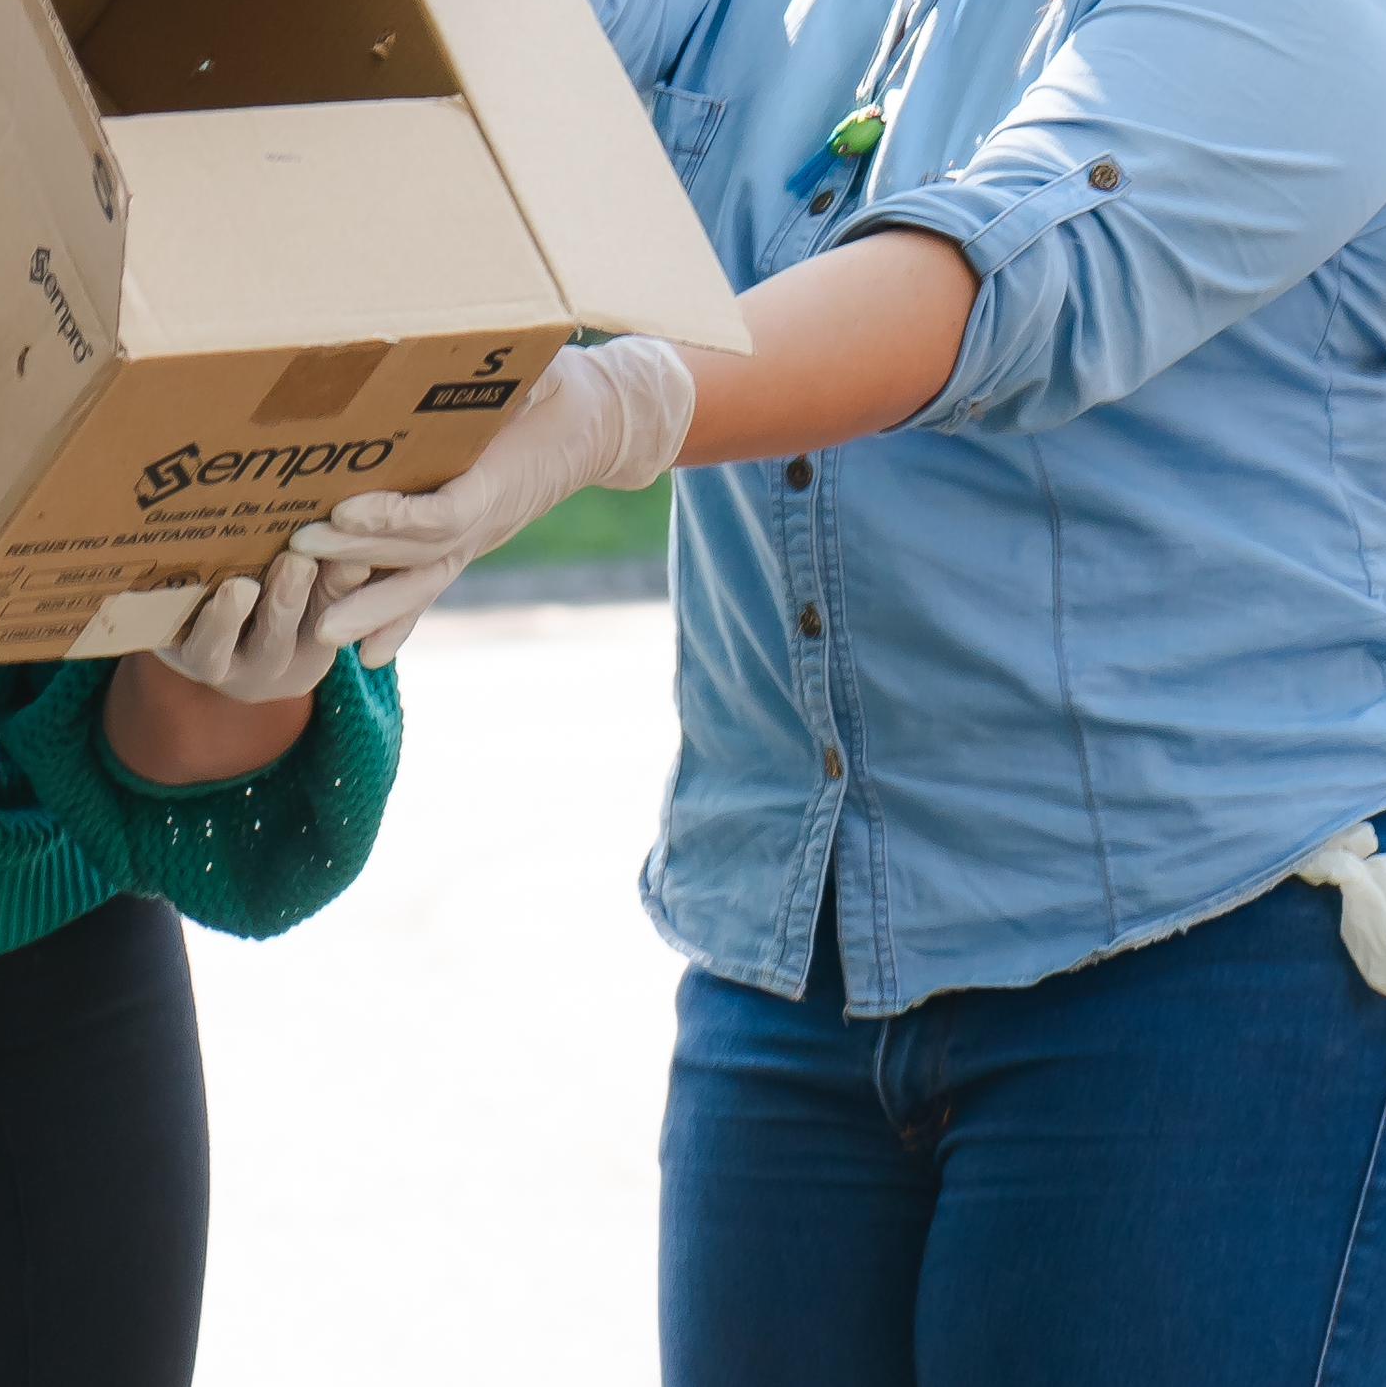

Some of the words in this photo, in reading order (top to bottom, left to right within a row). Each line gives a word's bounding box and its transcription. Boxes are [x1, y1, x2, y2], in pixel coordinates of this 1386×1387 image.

[471, 346, 514, 376] S
[452, 385, 506, 406] CAJAS
[110, 524, 217, 548] SANITARIO
